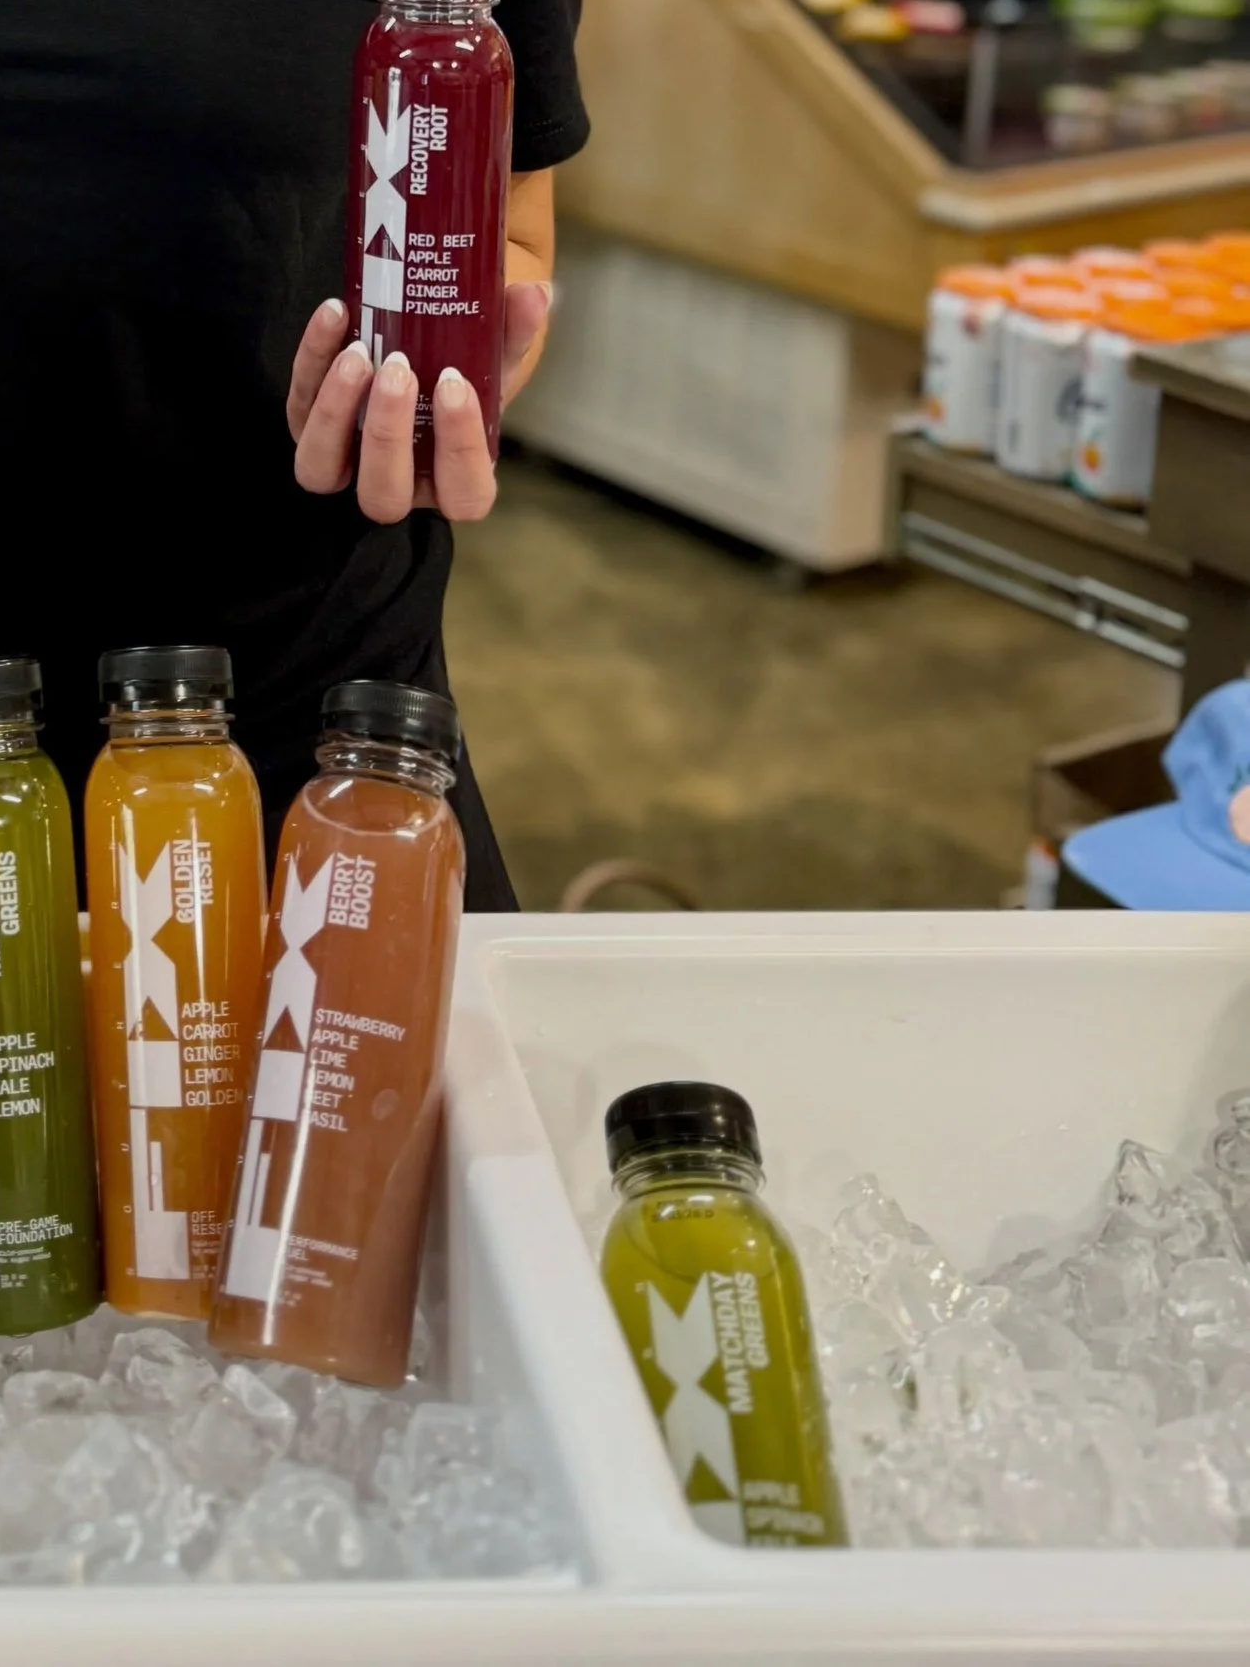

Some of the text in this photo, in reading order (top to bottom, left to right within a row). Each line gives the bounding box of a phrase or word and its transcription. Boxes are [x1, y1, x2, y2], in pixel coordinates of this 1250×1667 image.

[430, 104, 450, 152] ROOT
[409, 103, 431, 196] RECOVERY
[408, 232, 476, 248] RED BEET
[407, 251, 452, 265] APPLE
[407, 267, 459, 282] CARROT
[406, 284, 459, 299] GINGER
[405, 300, 480, 316] PINEAPPLE
[173, 838, 195, 924] GOLDEN
[195, 839, 214, 907] RESET
[327, 852, 355, 926] BERRY
[349, 854, 377, 930] BOOST
[182, 1002, 229, 1018] APPLE
[182, 1022, 239, 1041] CARROT
[315, 1007, 406, 1042] STRAWBERRY
[312, 1029, 359, 1050] APPLE
[118, 839, 191, 1280] FIX
[183, 1045, 241, 1062] GINGER
[185, 1067, 234, 1085] LEMON
[225, 852, 335, 1304] FIX
[311, 1069, 354, 1091] EMON
[185, 1088, 244, 1107] GOLDEN
[313, 1091, 342, 1108] EET
[310, 1110, 348, 1132] ASIL
[288, 1235, 359, 1260] ERFORMANCE
[288, 1249, 309, 1262] UEL
[736, 1270, 771, 1370] GREENS
[709, 1270, 755, 1414] MATCHDAY
